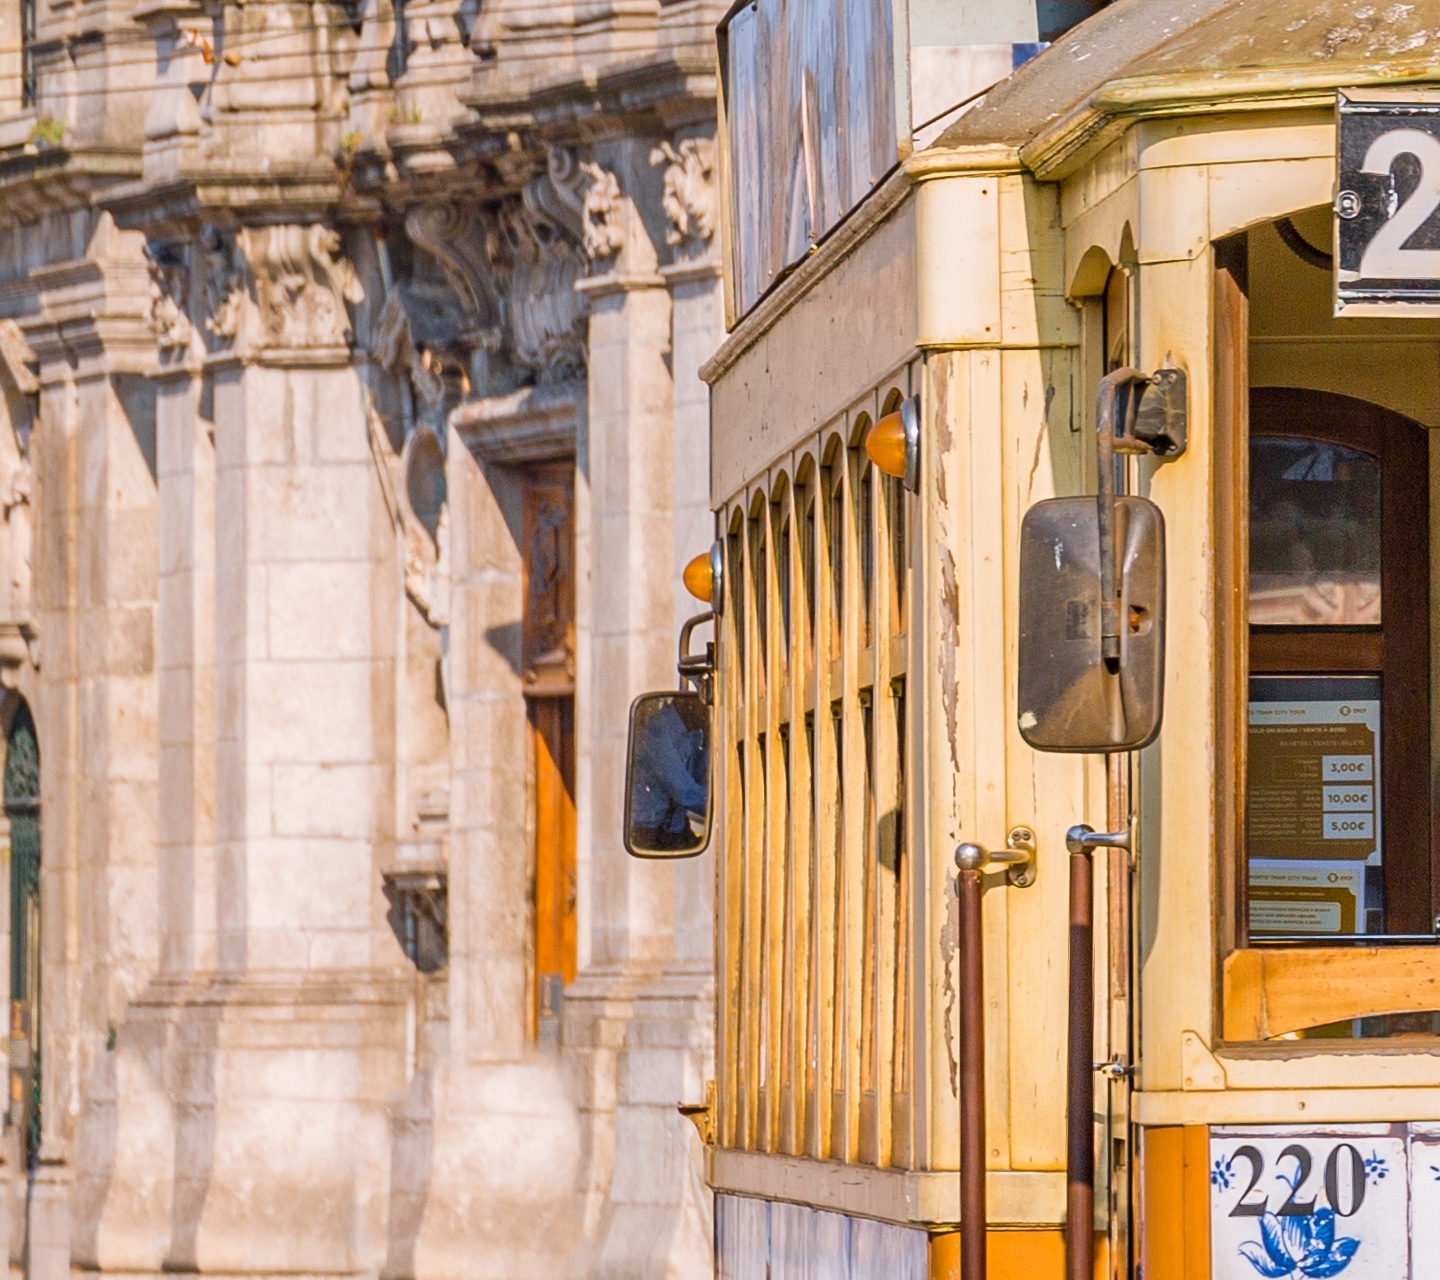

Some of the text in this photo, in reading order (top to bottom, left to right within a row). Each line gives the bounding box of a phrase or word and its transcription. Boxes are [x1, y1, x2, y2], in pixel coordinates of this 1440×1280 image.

[1330, 762, 1365, 774] 3,00€
[1327, 793, 1368, 805] 10,00€
[1331, 821, 1366, 832] 5,00€
[1228, 1142, 1367, 1218] 220
